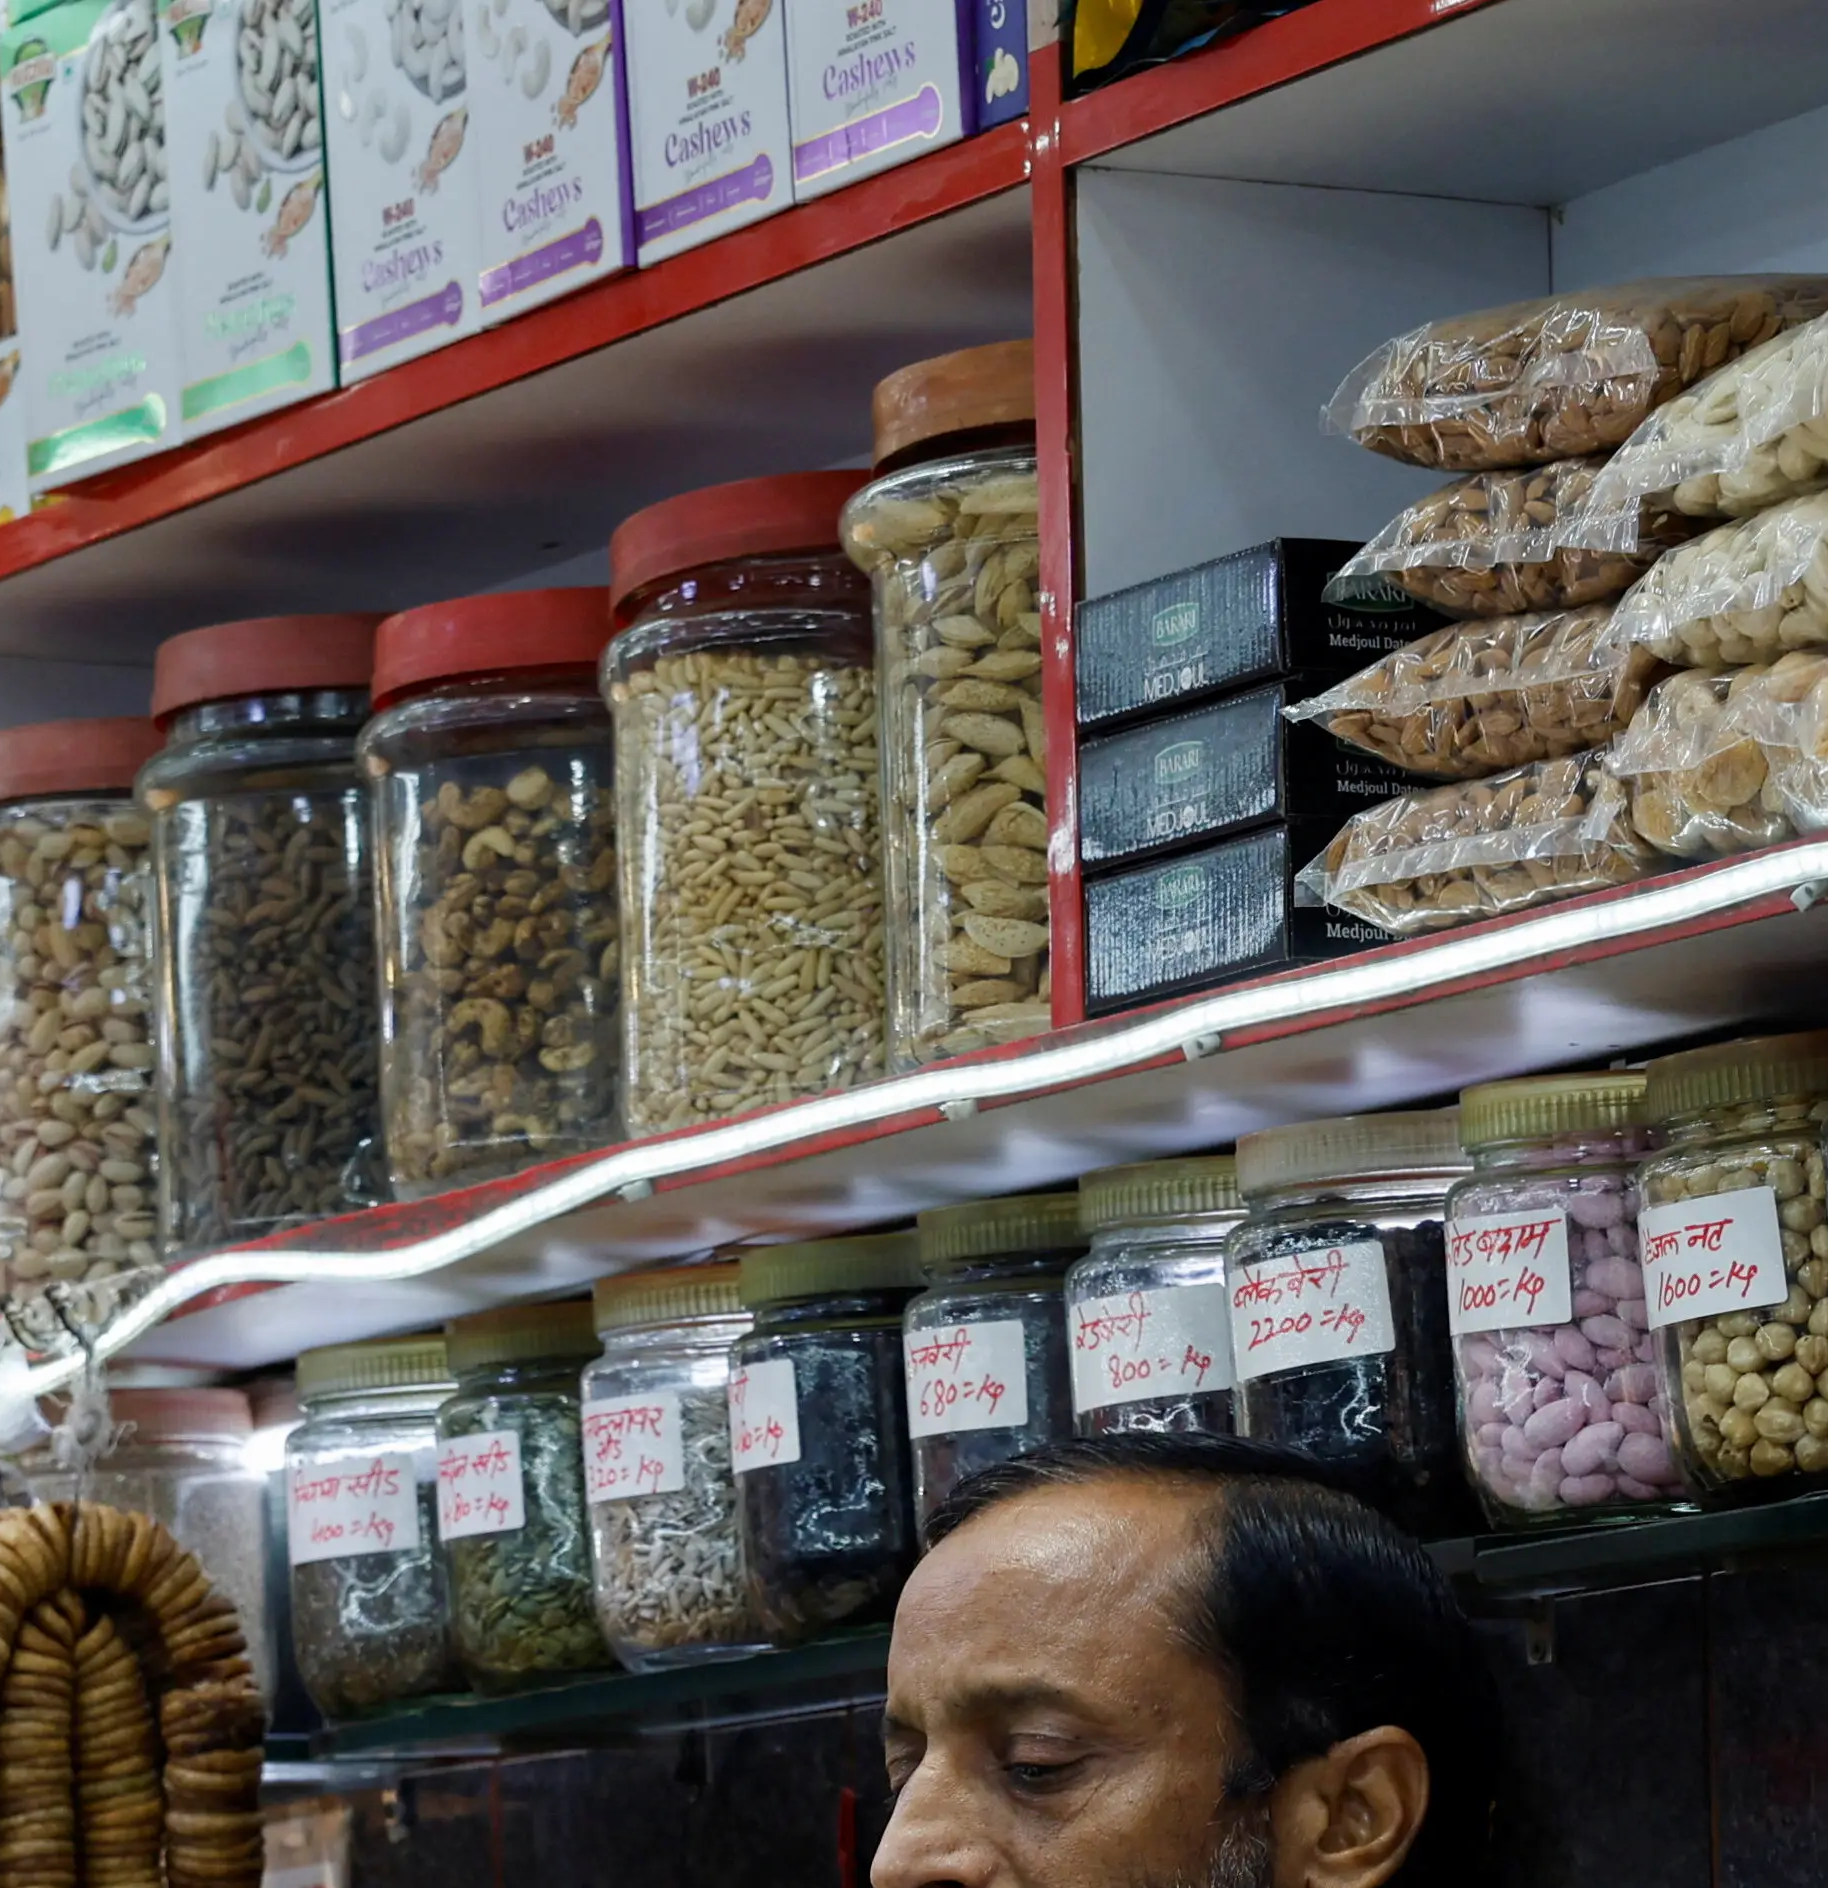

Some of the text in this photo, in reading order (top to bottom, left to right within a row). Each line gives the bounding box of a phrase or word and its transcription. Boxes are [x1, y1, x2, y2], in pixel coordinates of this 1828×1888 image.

[822, 41, 916, 100] Cashews
[664, 110, 752, 168] Cashews
[502, 176, 583, 232] Cashews
[361, 240, 443, 292] Cashews
[1157, 610, 1197, 638] BARARI
[1329, 633, 1380, 650] Medjoul
[1144, 661, 1209, 702] MEDJOUL
[1159, 747, 1200, 776] BARARI
[1337, 779, 1388, 796] Medjoul
[1146, 804, 1210, 839] MEDJOUL
